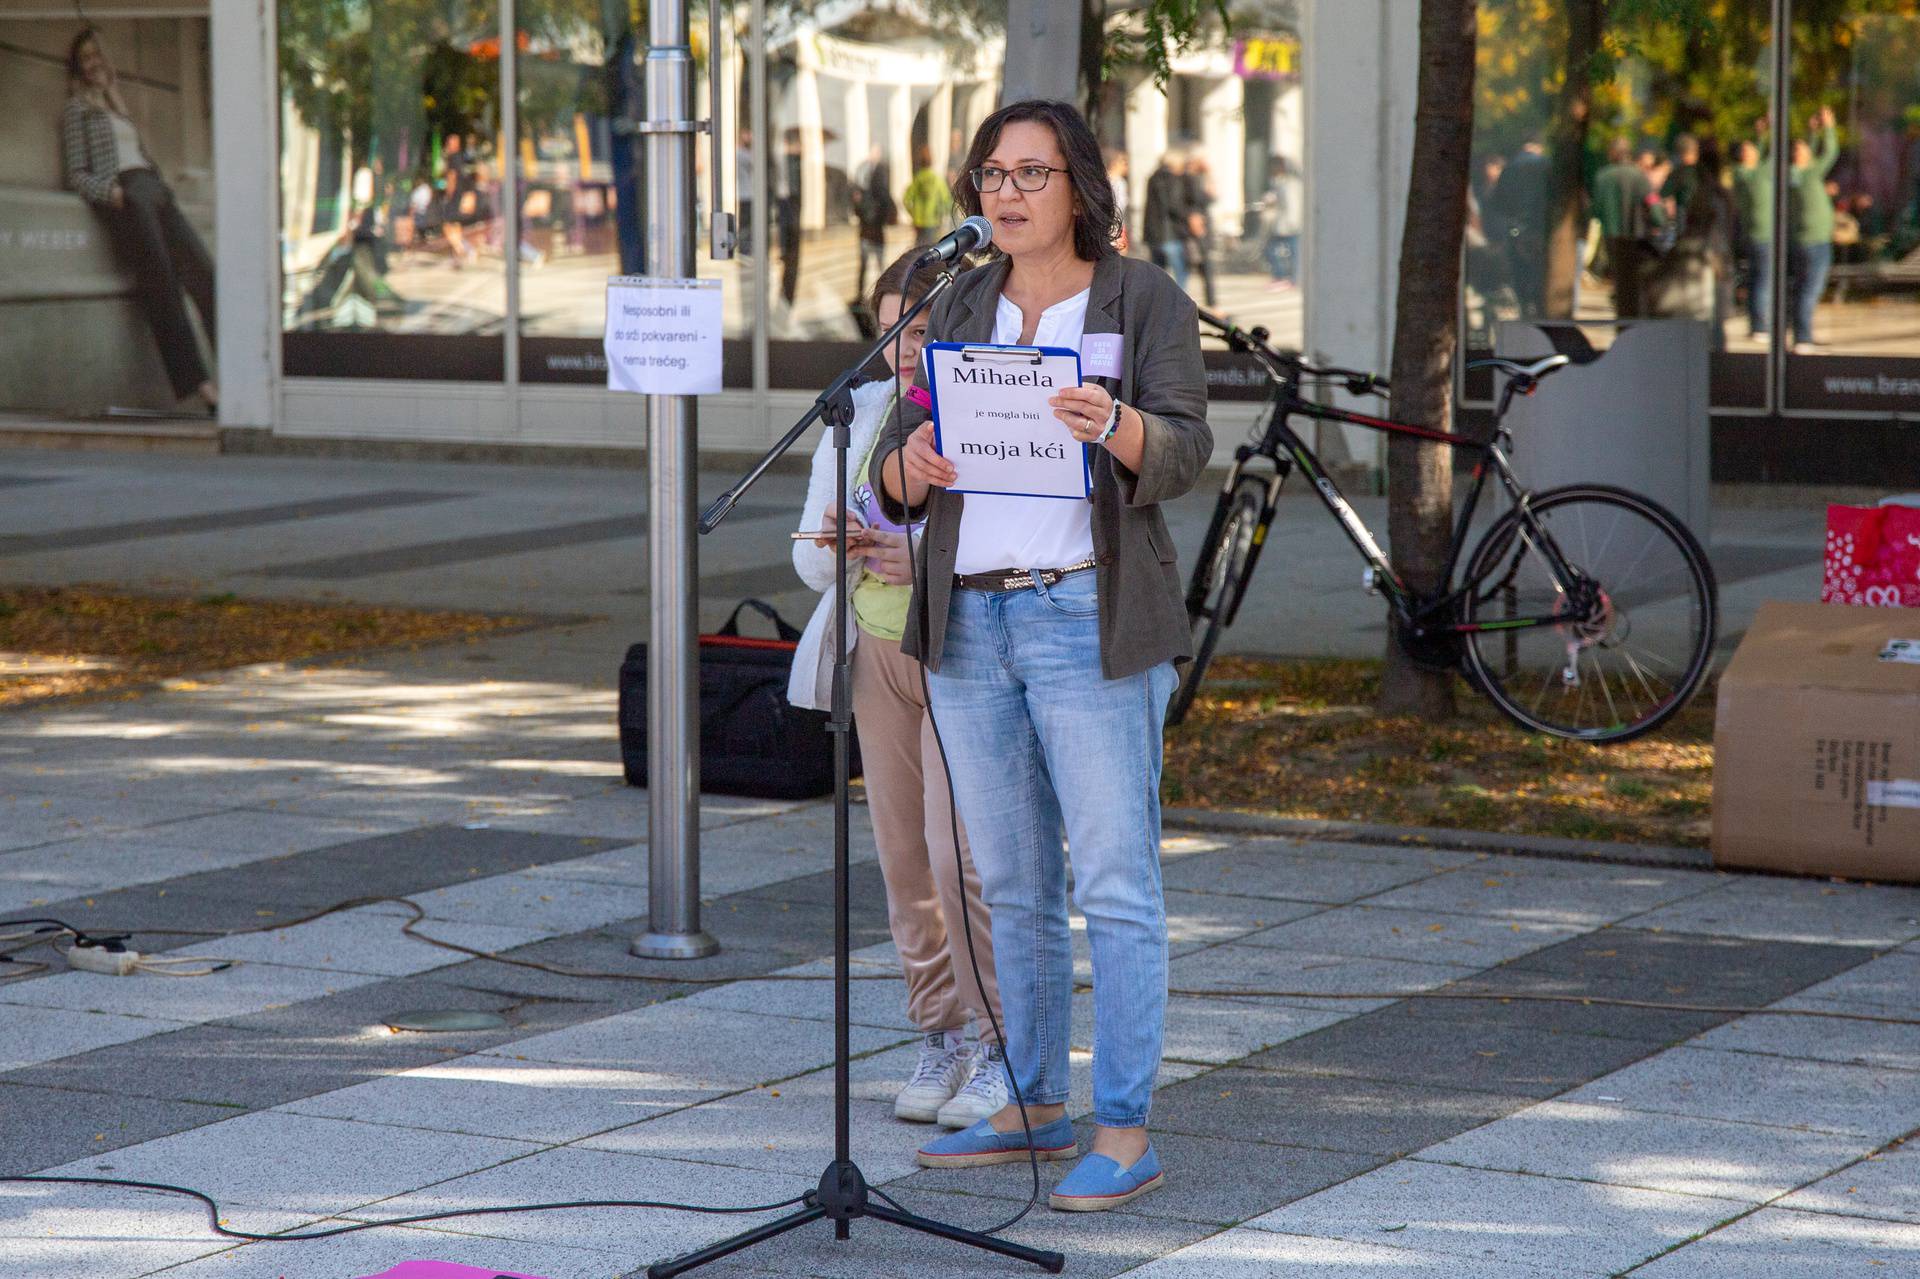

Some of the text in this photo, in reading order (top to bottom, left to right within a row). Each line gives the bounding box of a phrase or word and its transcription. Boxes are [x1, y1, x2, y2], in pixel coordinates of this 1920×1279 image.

[623, 304, 691, 318] Nesposobni ili
[615, 330, 625, 340] do
[641, 330, 698, 343] pokvareni
[623, 355, 646, 367] nema
[952, 367, 1054, 387] Mihaela
[974, 410, 1040, 420] je mogla biti
[960, 441, 1066, 460] moja kći
